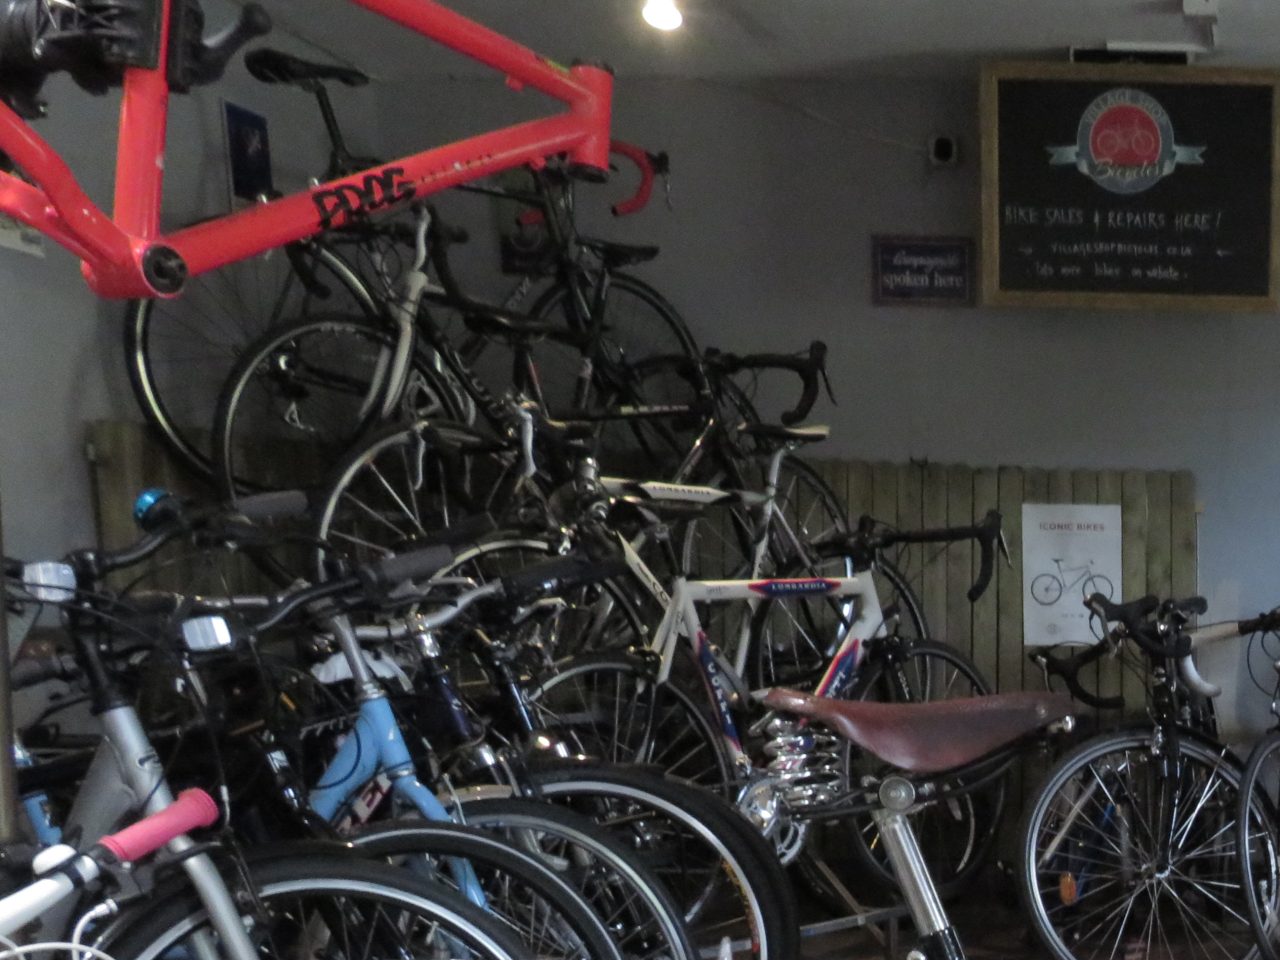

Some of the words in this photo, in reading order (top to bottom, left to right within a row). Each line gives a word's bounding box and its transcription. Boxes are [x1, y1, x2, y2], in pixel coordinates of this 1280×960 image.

[1005, 204, 1038, 225] BIKE
[1045, 208, 1083, 225] SALES
[1108, 211, 1165, 229] REPAIRS
[883, 269, 929, 289] spoken
[934, 271, 963, 287] here
[1040, 522, 1073, 531] ICONIC
[1076, 522, 1105, 531] BIKES
[771, 583, 827, 591] LOMBARDIA
